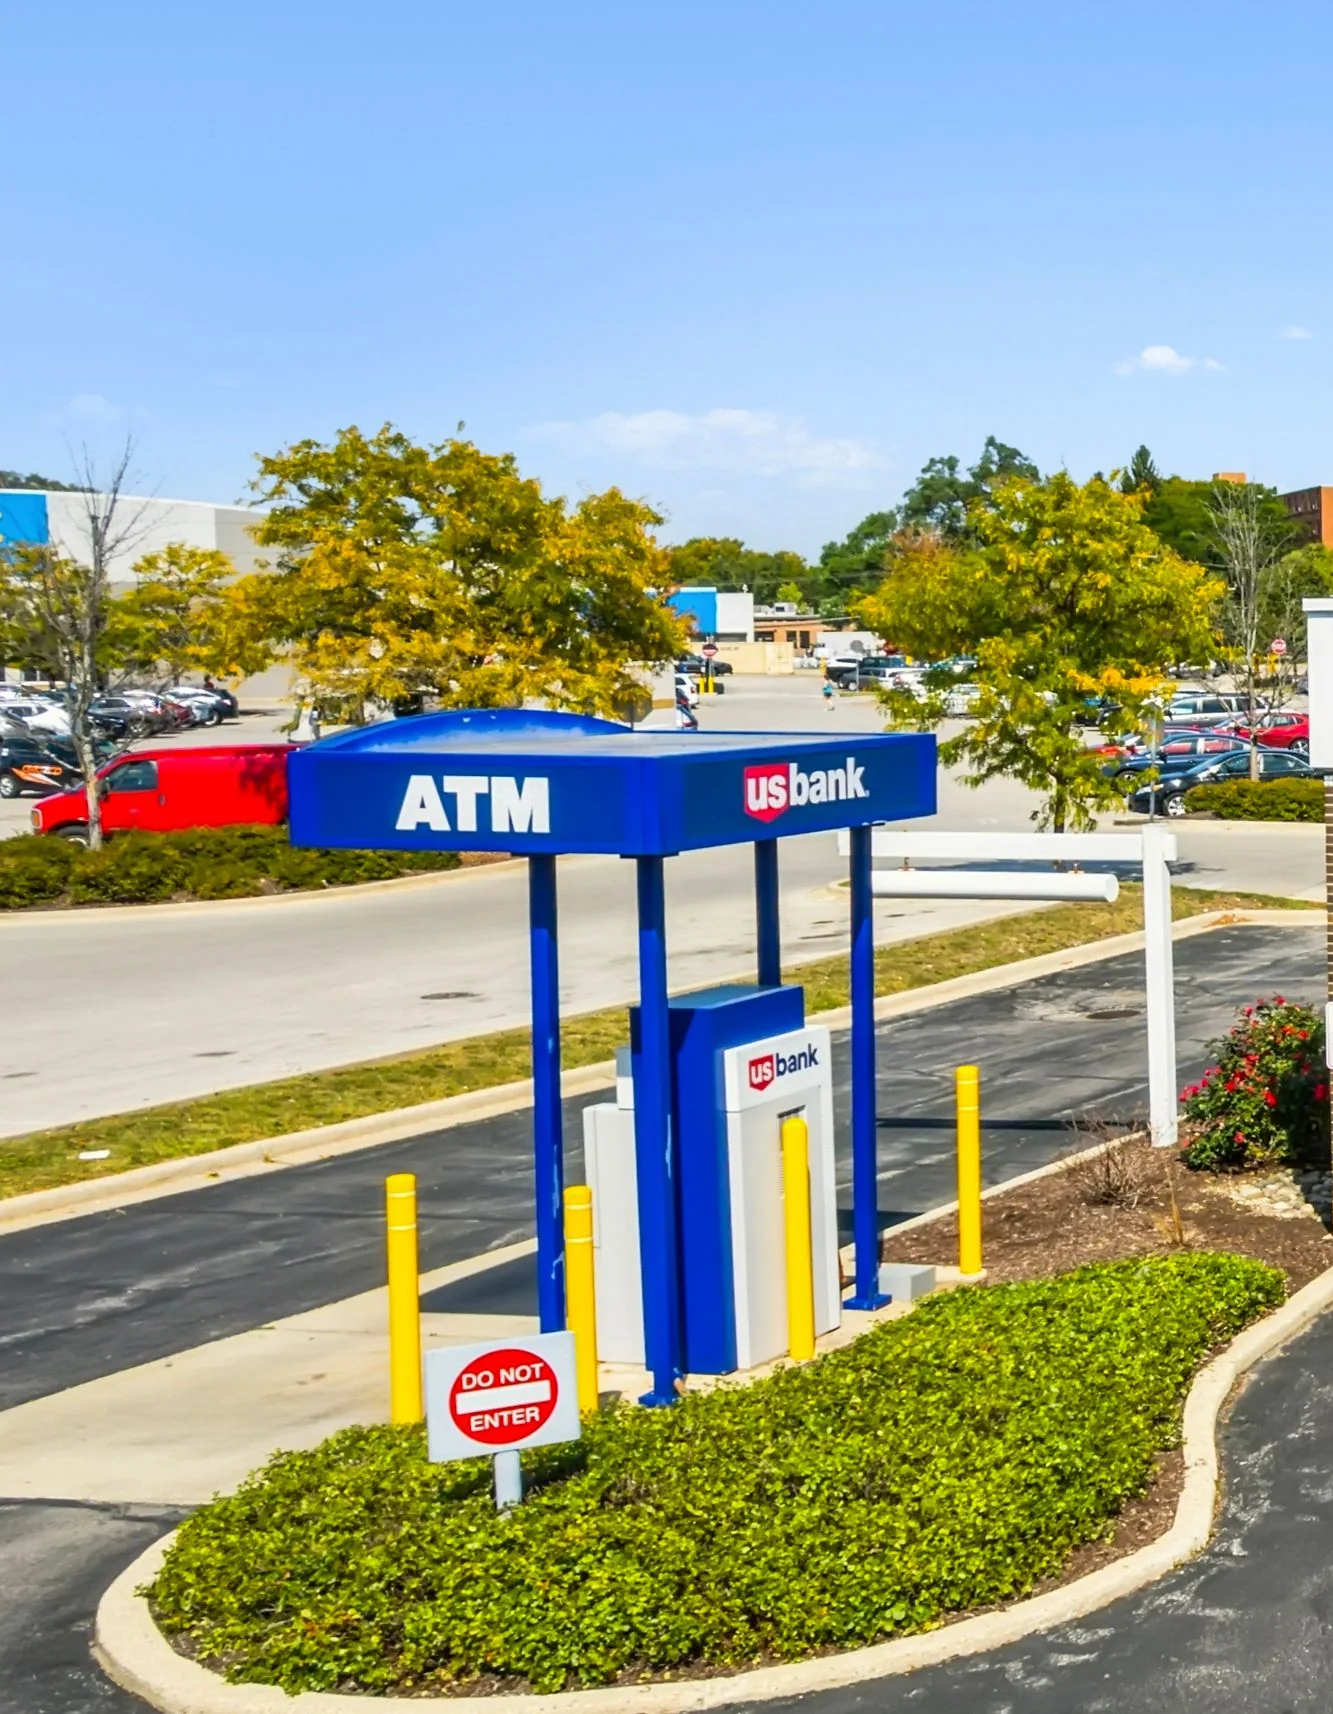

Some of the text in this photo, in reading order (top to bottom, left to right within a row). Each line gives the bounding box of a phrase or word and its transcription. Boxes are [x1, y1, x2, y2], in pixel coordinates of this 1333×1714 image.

[395, 774, 551, 834] ATM
[461, 1362, 545, 1391] DO NOT
[470, 1406, 540, 1433] ENTER
